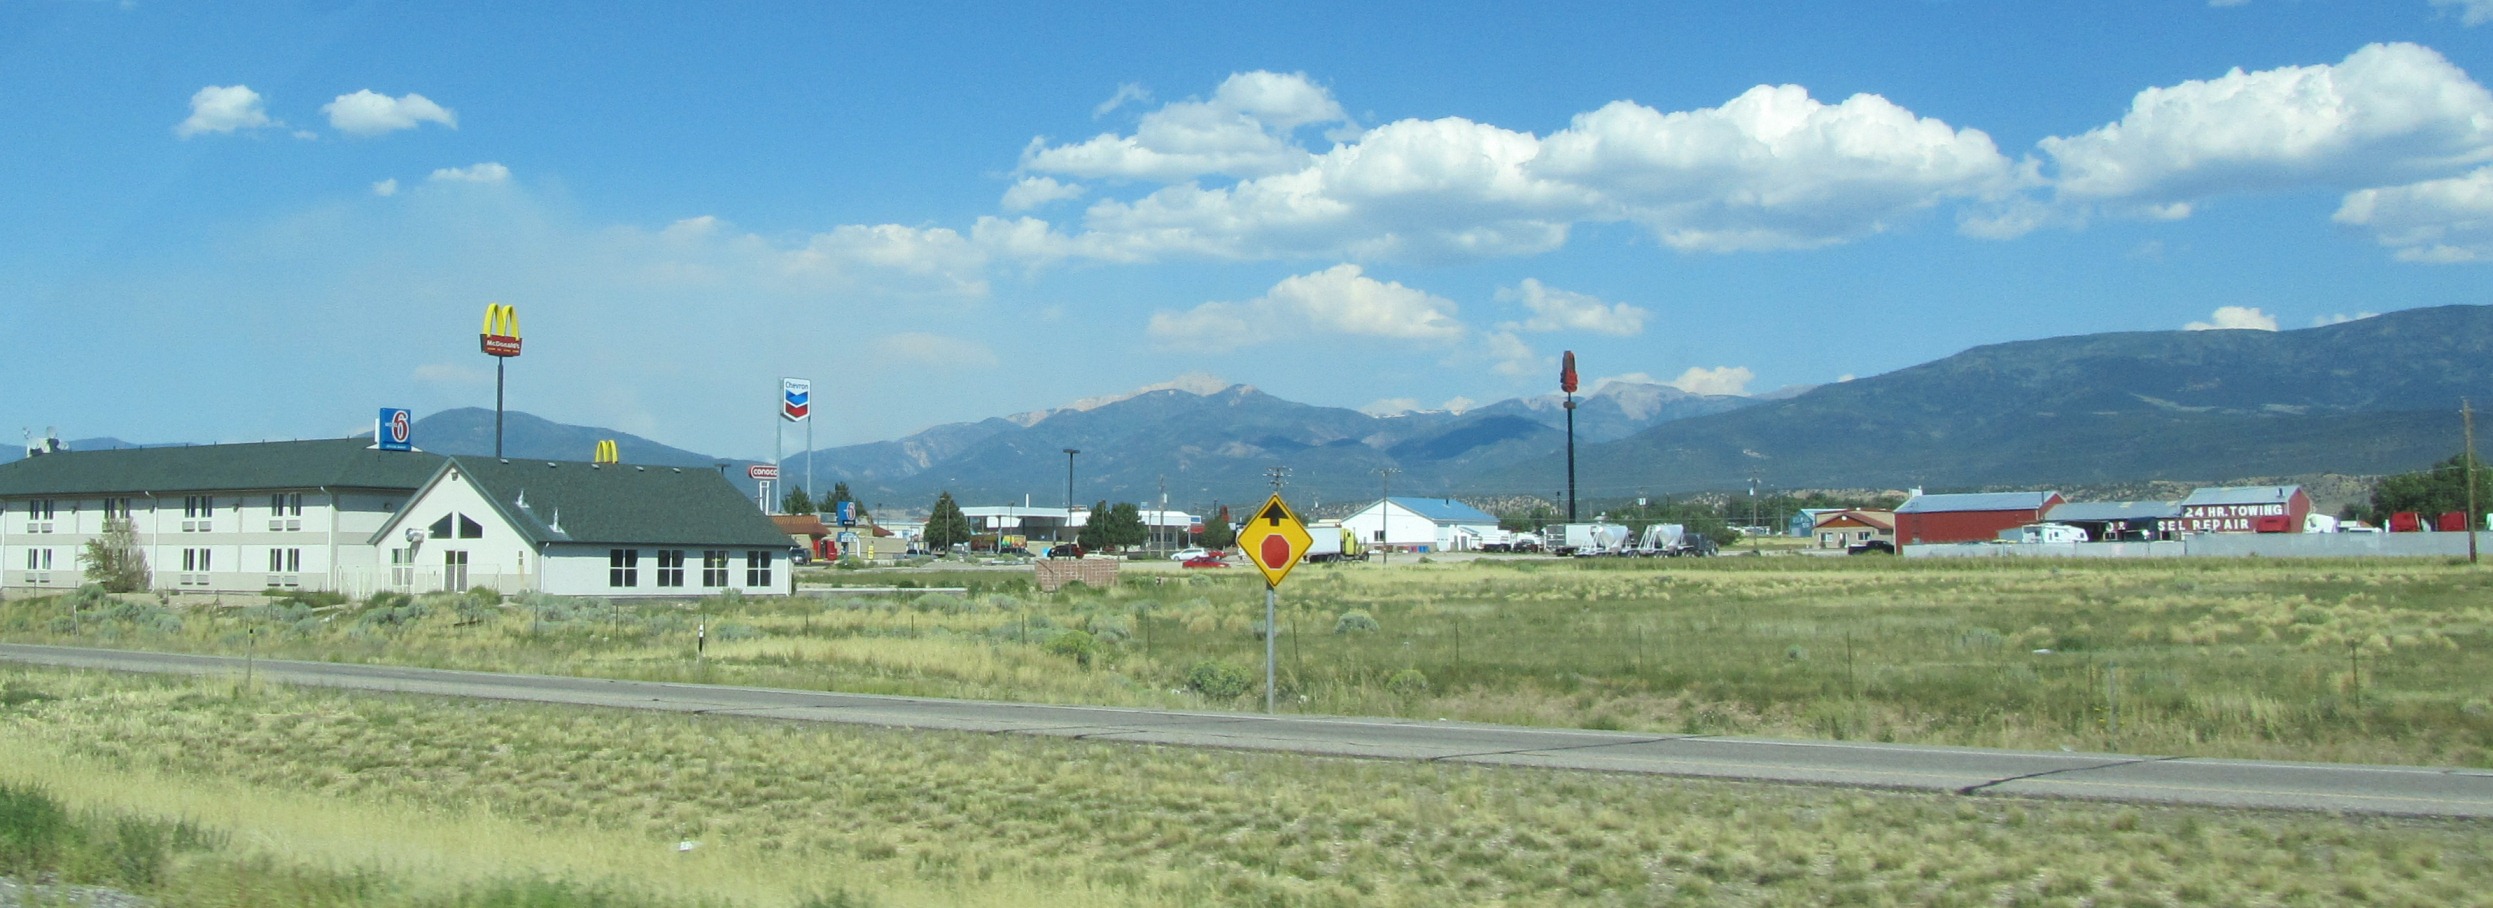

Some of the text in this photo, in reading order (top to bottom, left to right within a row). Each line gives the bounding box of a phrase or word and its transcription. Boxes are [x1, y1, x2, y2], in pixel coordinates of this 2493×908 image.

[785, 381, 809, 390] Chevron
[392, 410, 410, 443] 6
[2184, 504, 2283, 518] 24 HR. TOWING
[2192, 518, 2250, 531] REPAIR
